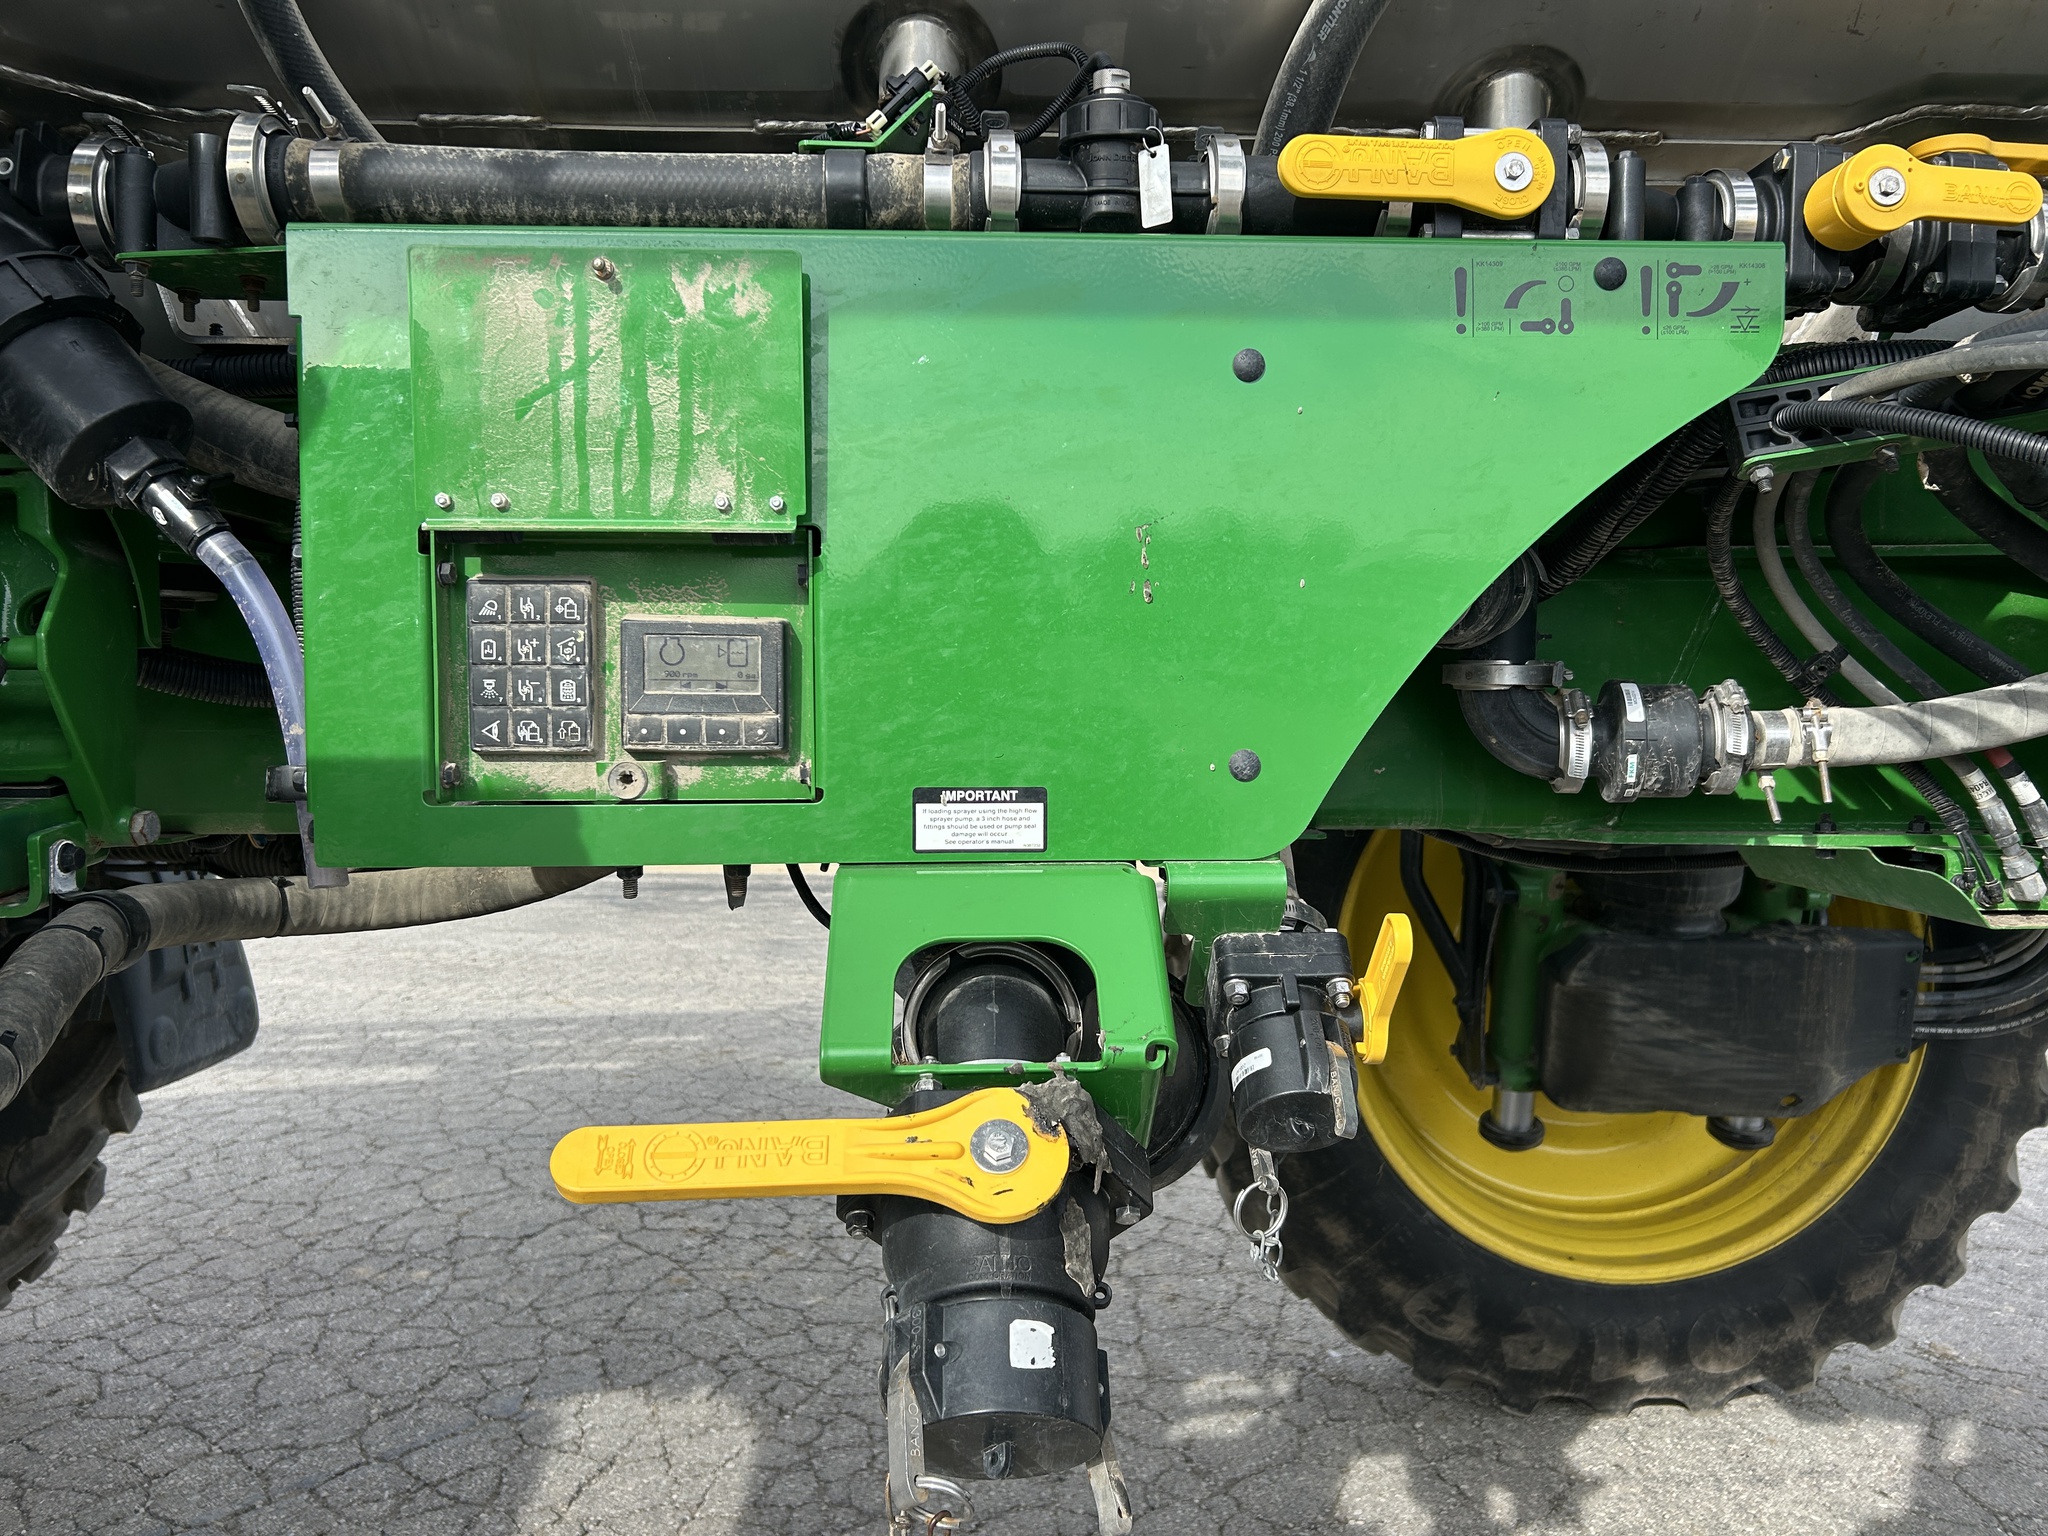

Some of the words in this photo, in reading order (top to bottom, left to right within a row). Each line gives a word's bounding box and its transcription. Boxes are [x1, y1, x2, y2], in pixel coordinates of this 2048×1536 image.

[1316, 0, 1351, 41] ONTIER
[1275, 92, 1297, 135] (38.1mm)
[1271, 133, 1283, 150] 200
[1497, 140, 1531, 151] OPEN
[1114, 154, 1137, 162] DEER
[1988, 650, 2027, 680] AGOMMA
[1628, 761, 1636, 778] FKM
[942, 790, 1018, 802] IMPORTANT
[1330, 1070, 1342, 1105] BANJO
[605, 1146, 615, 1170] OPEN
[966, 1254, 1032, 1272] BANJO
[910, 1404, 921, 1458] BANJO
